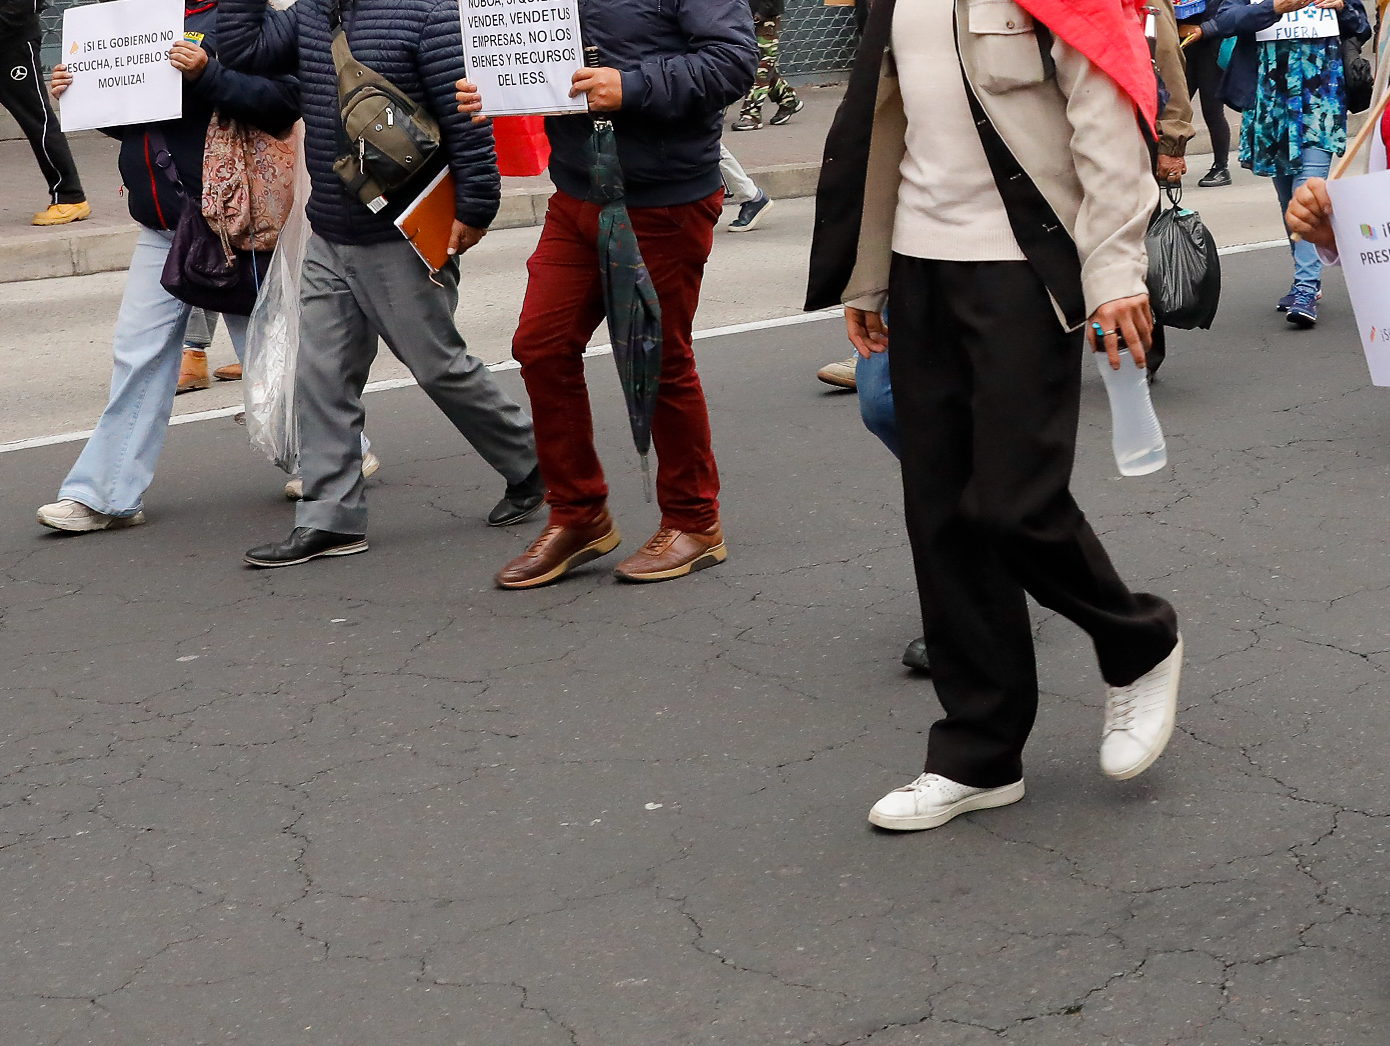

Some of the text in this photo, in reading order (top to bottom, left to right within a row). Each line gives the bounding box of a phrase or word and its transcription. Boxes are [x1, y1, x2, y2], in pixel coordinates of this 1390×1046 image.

[467, 7, 570, 29] VENDER, VENDE TUS
[83, 30, 174, 54] ¡SI EL GOBIERNO NO
[472, 28, 572, 48] EMPRESAS, NO LOS
[1276, 26, 1319, 41] FUERA
[67, 58, 113, 73] ESCUCHA,
[115, 56, 125, 68] EL
[127, 51, 160, 66] PUEBLO
[471, 48, 576, 68] BIENES Y RECURSOS
[98, 72, 145, 89] MOVILIZA!
[498, 71, 549, 87] DEL IESS.
